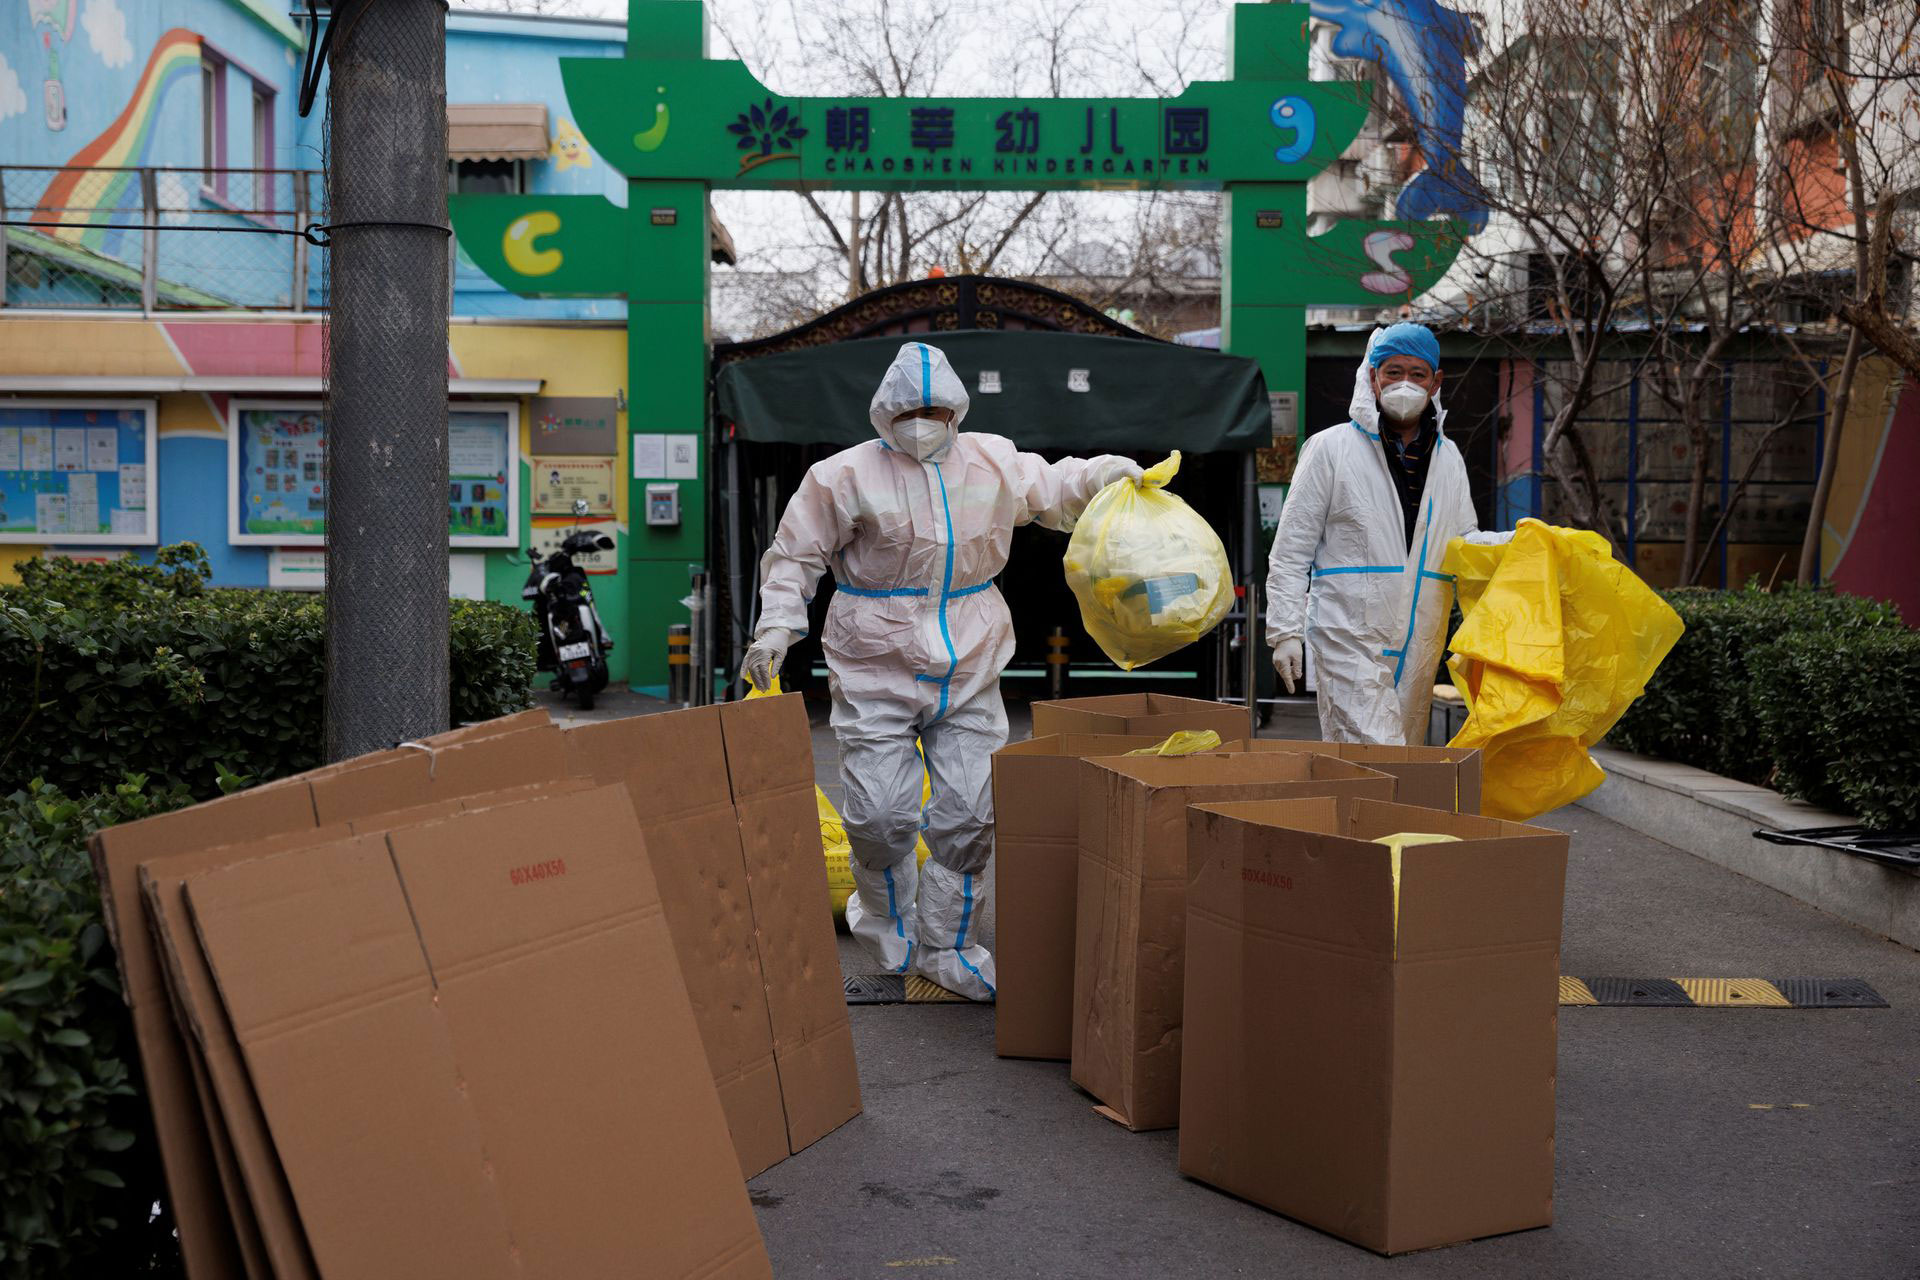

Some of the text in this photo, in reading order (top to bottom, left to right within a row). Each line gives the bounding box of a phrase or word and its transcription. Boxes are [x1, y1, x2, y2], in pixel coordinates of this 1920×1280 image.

[825, 106, 1210, 154] 朝莘幼儿园
[825, 158, 1210, 174] CHAOSHEN KINDERGARTEN
